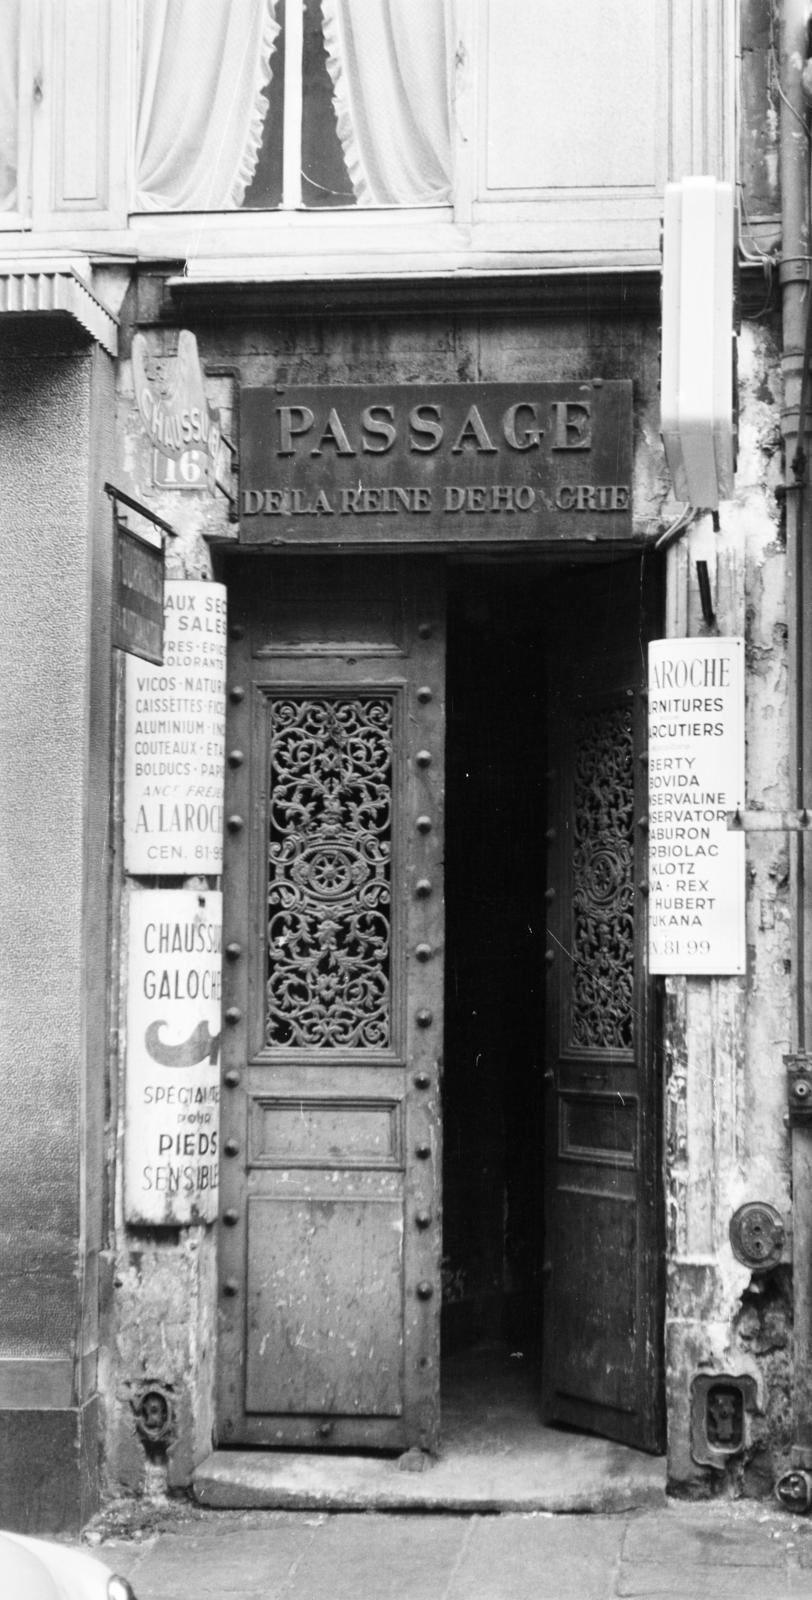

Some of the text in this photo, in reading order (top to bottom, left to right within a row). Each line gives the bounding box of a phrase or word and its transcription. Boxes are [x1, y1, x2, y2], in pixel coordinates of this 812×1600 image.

[275, 401, 592, 456] PASSAGE
[163, 449, 201, 482] 16
[242, 484, 631, 516] DE LA REINE DE HOGRIE
[136, 677, 177, 692] VICOS
[135, 698, 203, 714] CAISSETTES
[134, 720, 205, 735] ALUMINIUM
[134, 741, 197, 756] COUTEAUX
[135, 762, 191, 777] BOLDUCS
[147, 845, 188, 860] CEN.
[676, 879, 709, 892] REX
[655, 897, 717, 911] HUBERT
[159, 1131, 217, 1156] PIEDS
